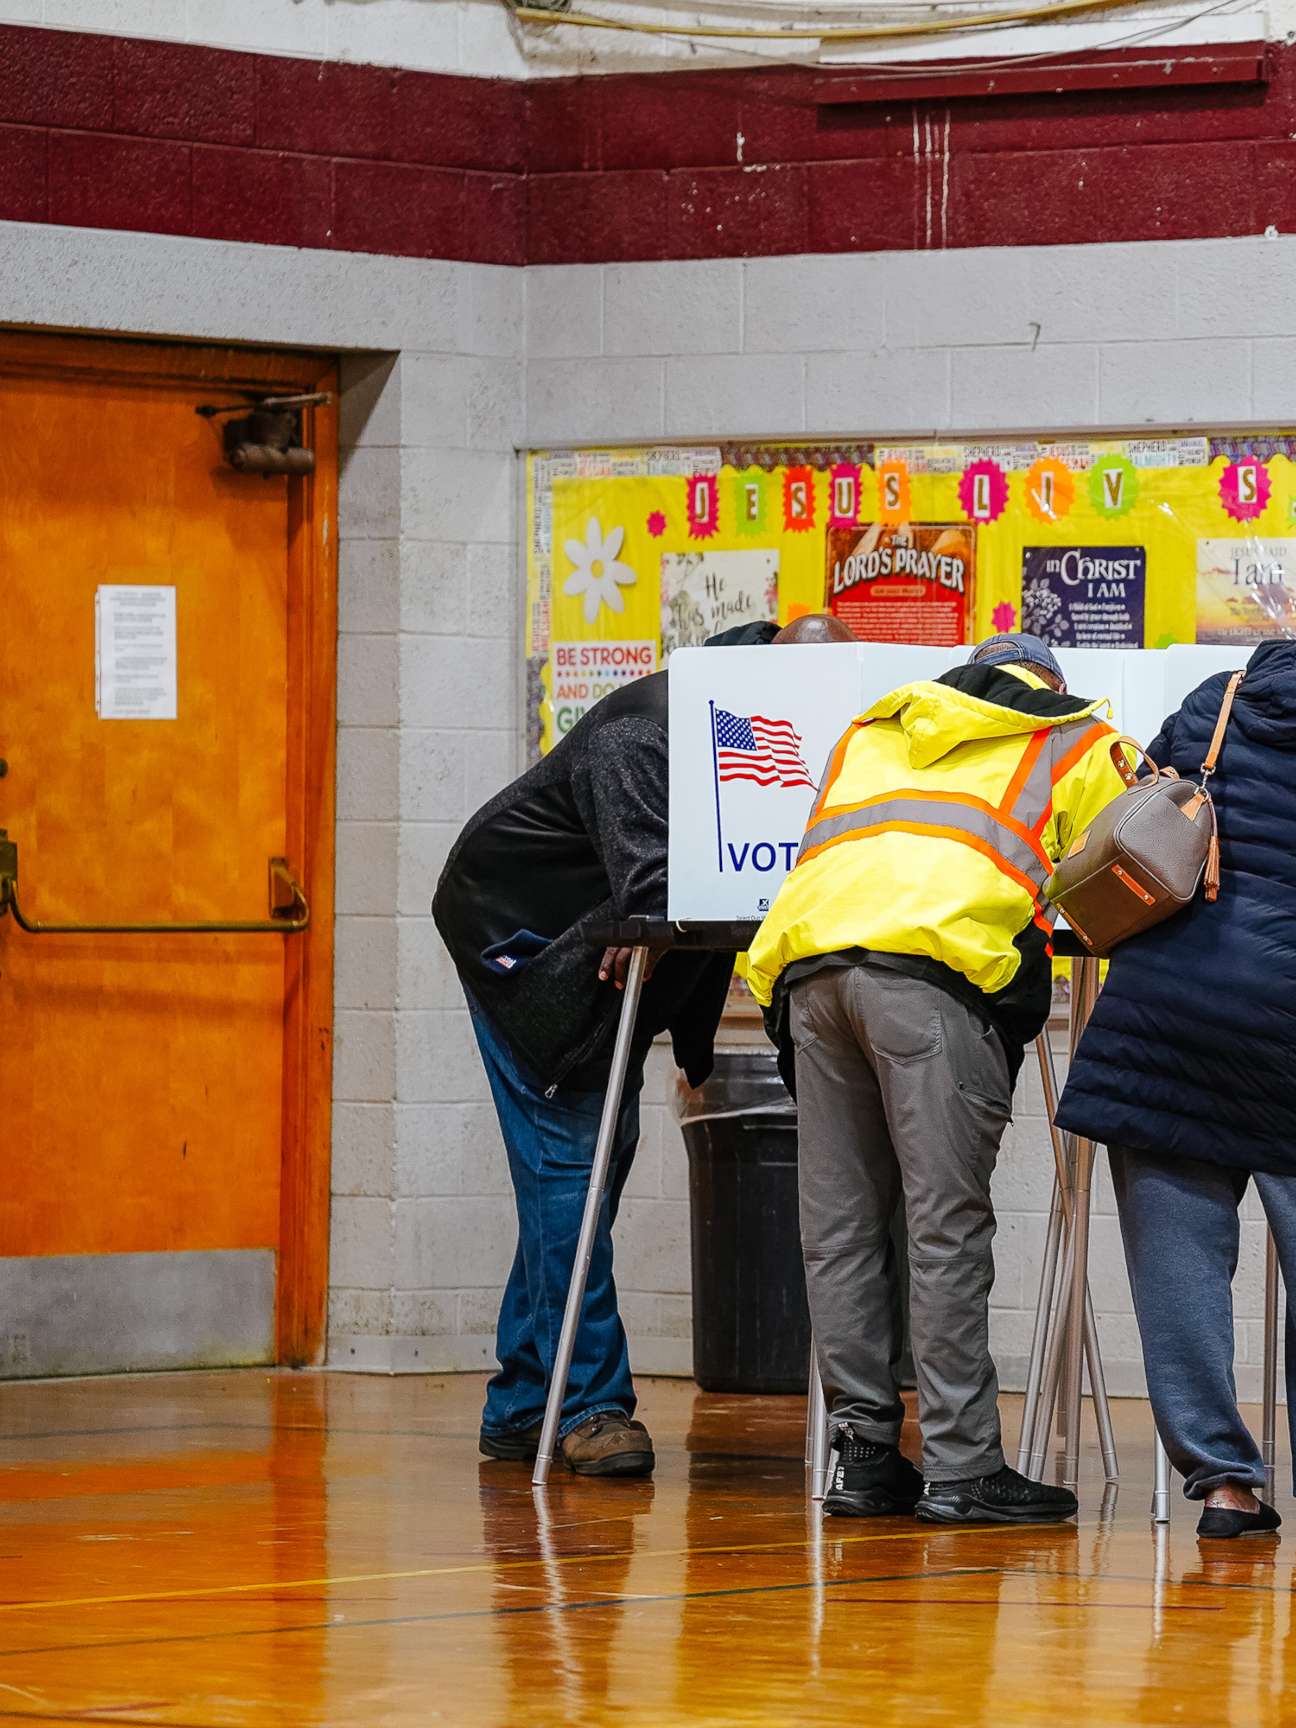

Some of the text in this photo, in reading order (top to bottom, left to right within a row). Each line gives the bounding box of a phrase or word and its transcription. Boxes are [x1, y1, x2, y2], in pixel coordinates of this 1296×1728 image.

[697, 475, 900, 521] JESUS
[890, 534, 909, 547] THE
[833, 547, 965, 594] LORD'S PRAYER
[1233, 558, 1239, 585] I
[705, 572, 727, 602] He
[1088, 582, 1126, 598] I AM
[711, 590, 753, 620] made
[556, 648, 577, 666] BE
[581, 646, 653, 666] STRONG
[556, 684, 589, 700] AND
[727, 842, 800, 872] VOT
